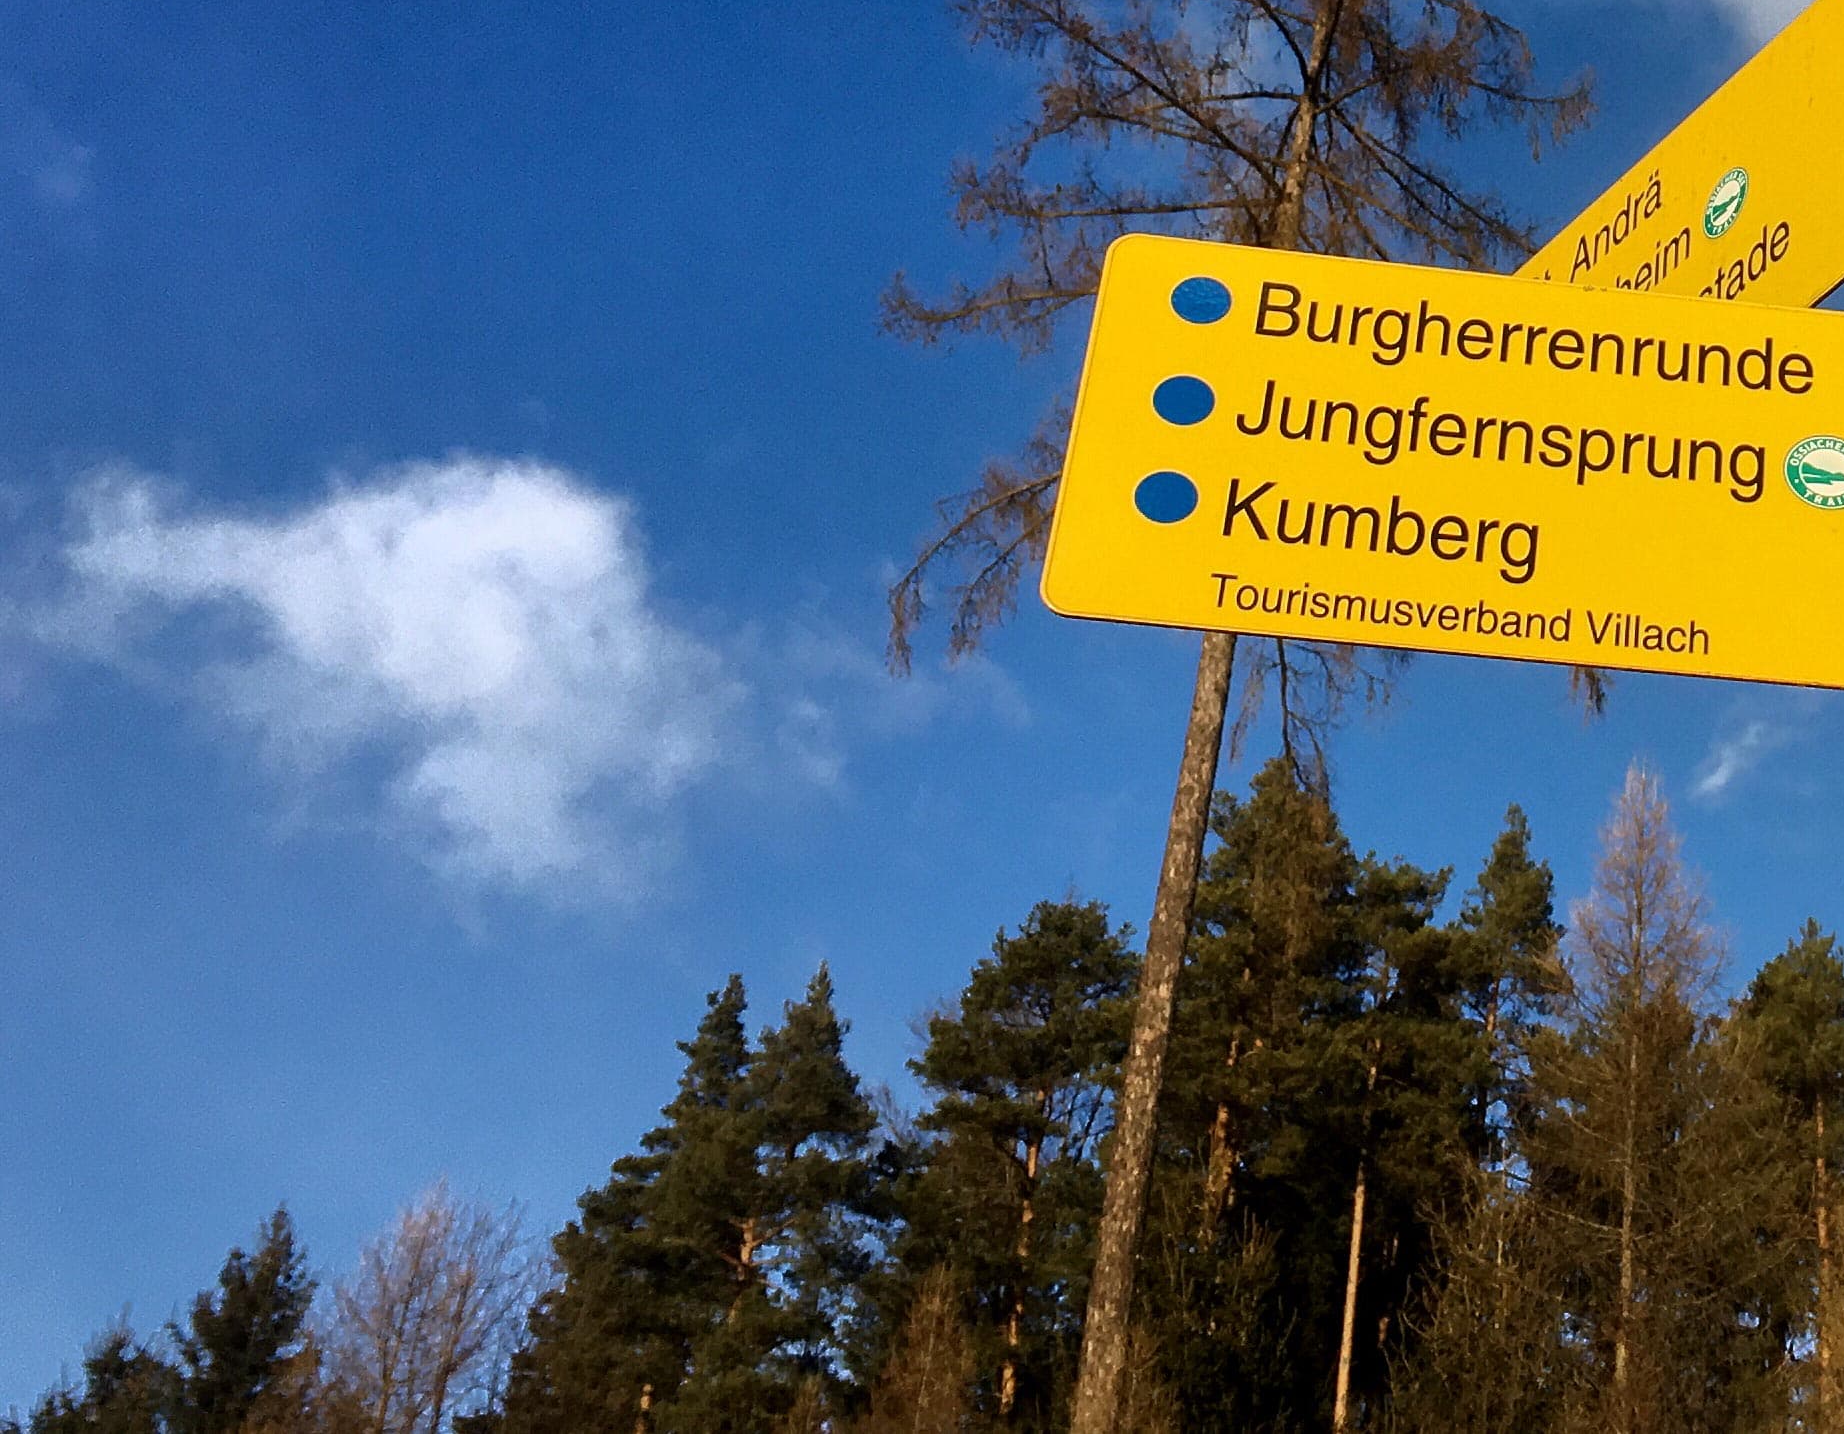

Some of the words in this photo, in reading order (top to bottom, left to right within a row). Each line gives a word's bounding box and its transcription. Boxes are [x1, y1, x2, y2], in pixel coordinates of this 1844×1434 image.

[1570, 169, 1662, 283] Andrä
[1255, 281, 1814, 394] Burgherrenrunde
[1236, 379, 1765, 503] Jungfernsprung
[1222, 478, 1539, 584] Kumberg
[1211, 573, 1571, 642] Tourismusverband
[1586, 610, 1709, 655] Villach
